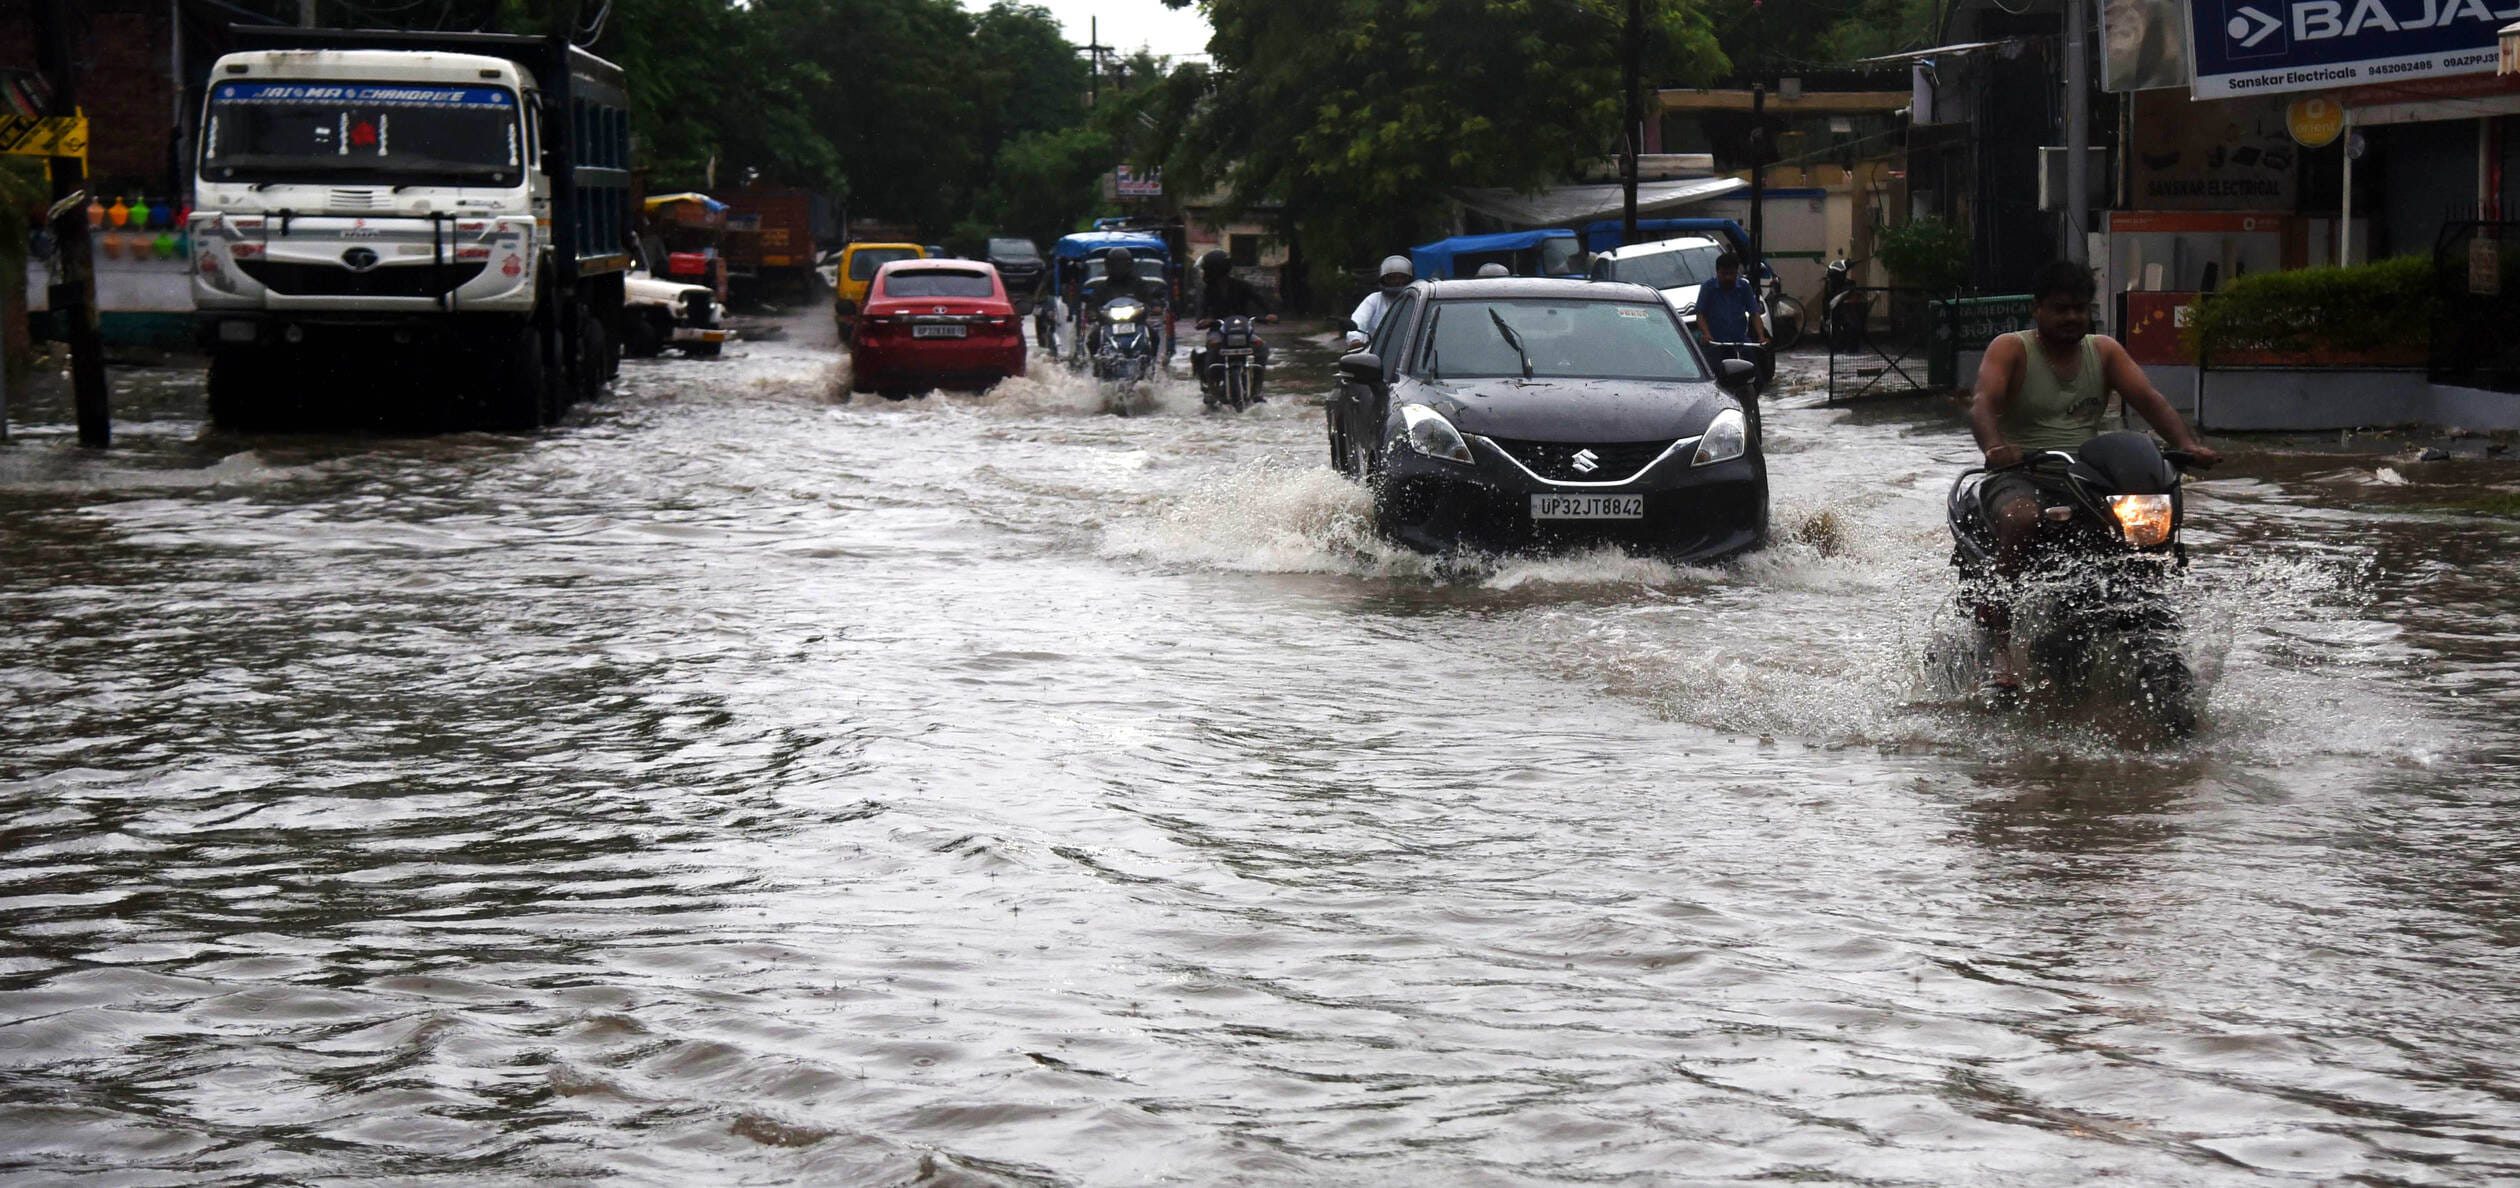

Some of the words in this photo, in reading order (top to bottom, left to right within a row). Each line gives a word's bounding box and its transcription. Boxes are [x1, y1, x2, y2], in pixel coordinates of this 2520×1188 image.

[2229, 75, 2284, 89] Sanskar
[2287, 67, 2357, 84] Electricals
[253, 87, 293, 98] JAI
[304, 87, 343, 98] MA
[1541, 498, 1642, 516] UP32JT8842
